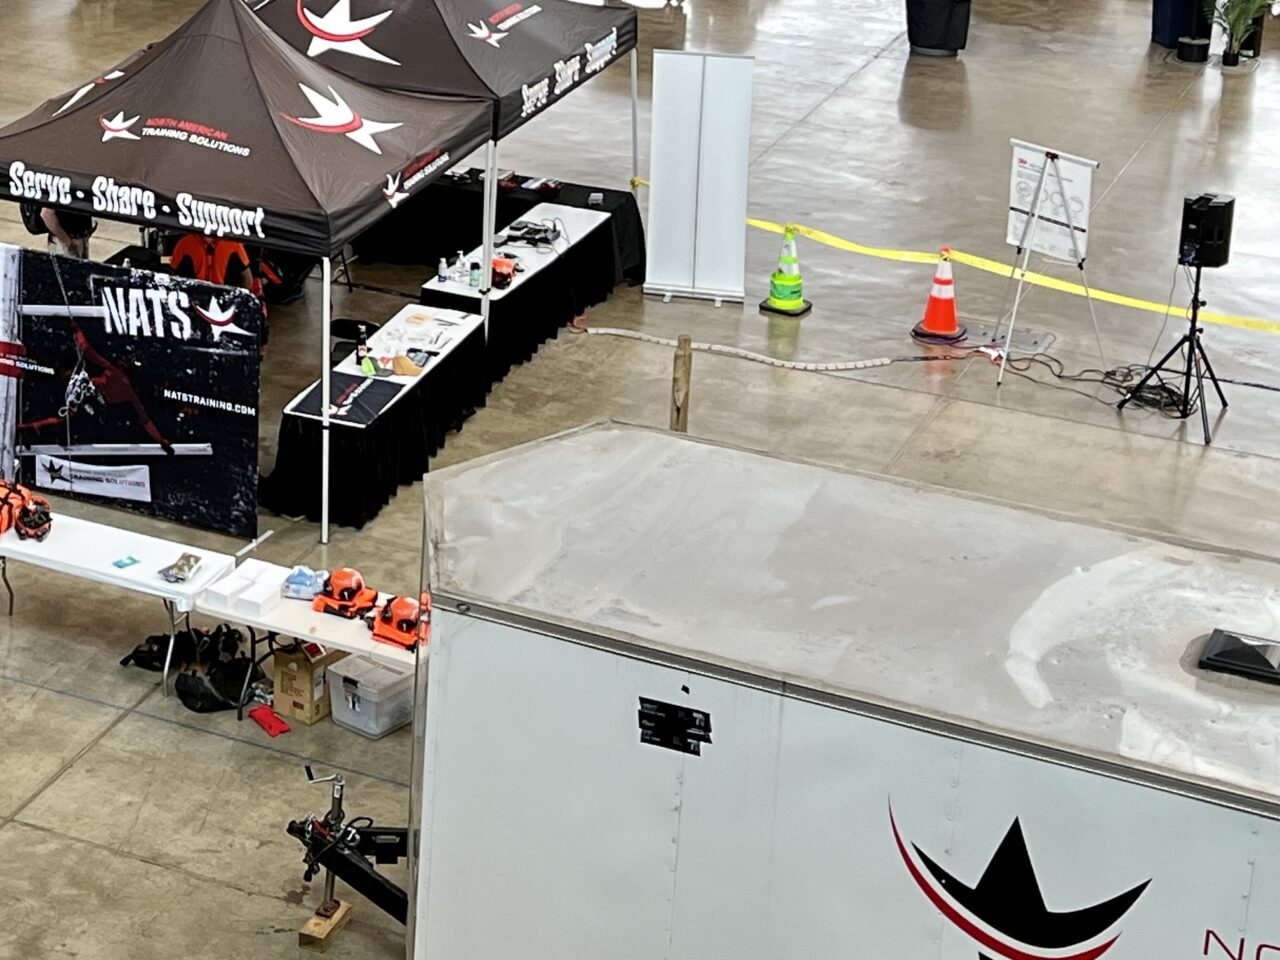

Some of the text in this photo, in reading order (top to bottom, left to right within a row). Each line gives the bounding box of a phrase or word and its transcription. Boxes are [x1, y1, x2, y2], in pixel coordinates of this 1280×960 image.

[145, 117, 228, 140] NORTH AMERICAN
[142, 128, 251, 157] TRAINING SOLUTIONS
[8, 160, 266, 238] Serve Share Support
[101, 286, 192, 340] NATS
[15, 360, 55, 375] SOLUTIONS
[164, 389, 256, 416] NATSTRAINING.COM
[105, 477, 146, 488] SOLUTIONS
